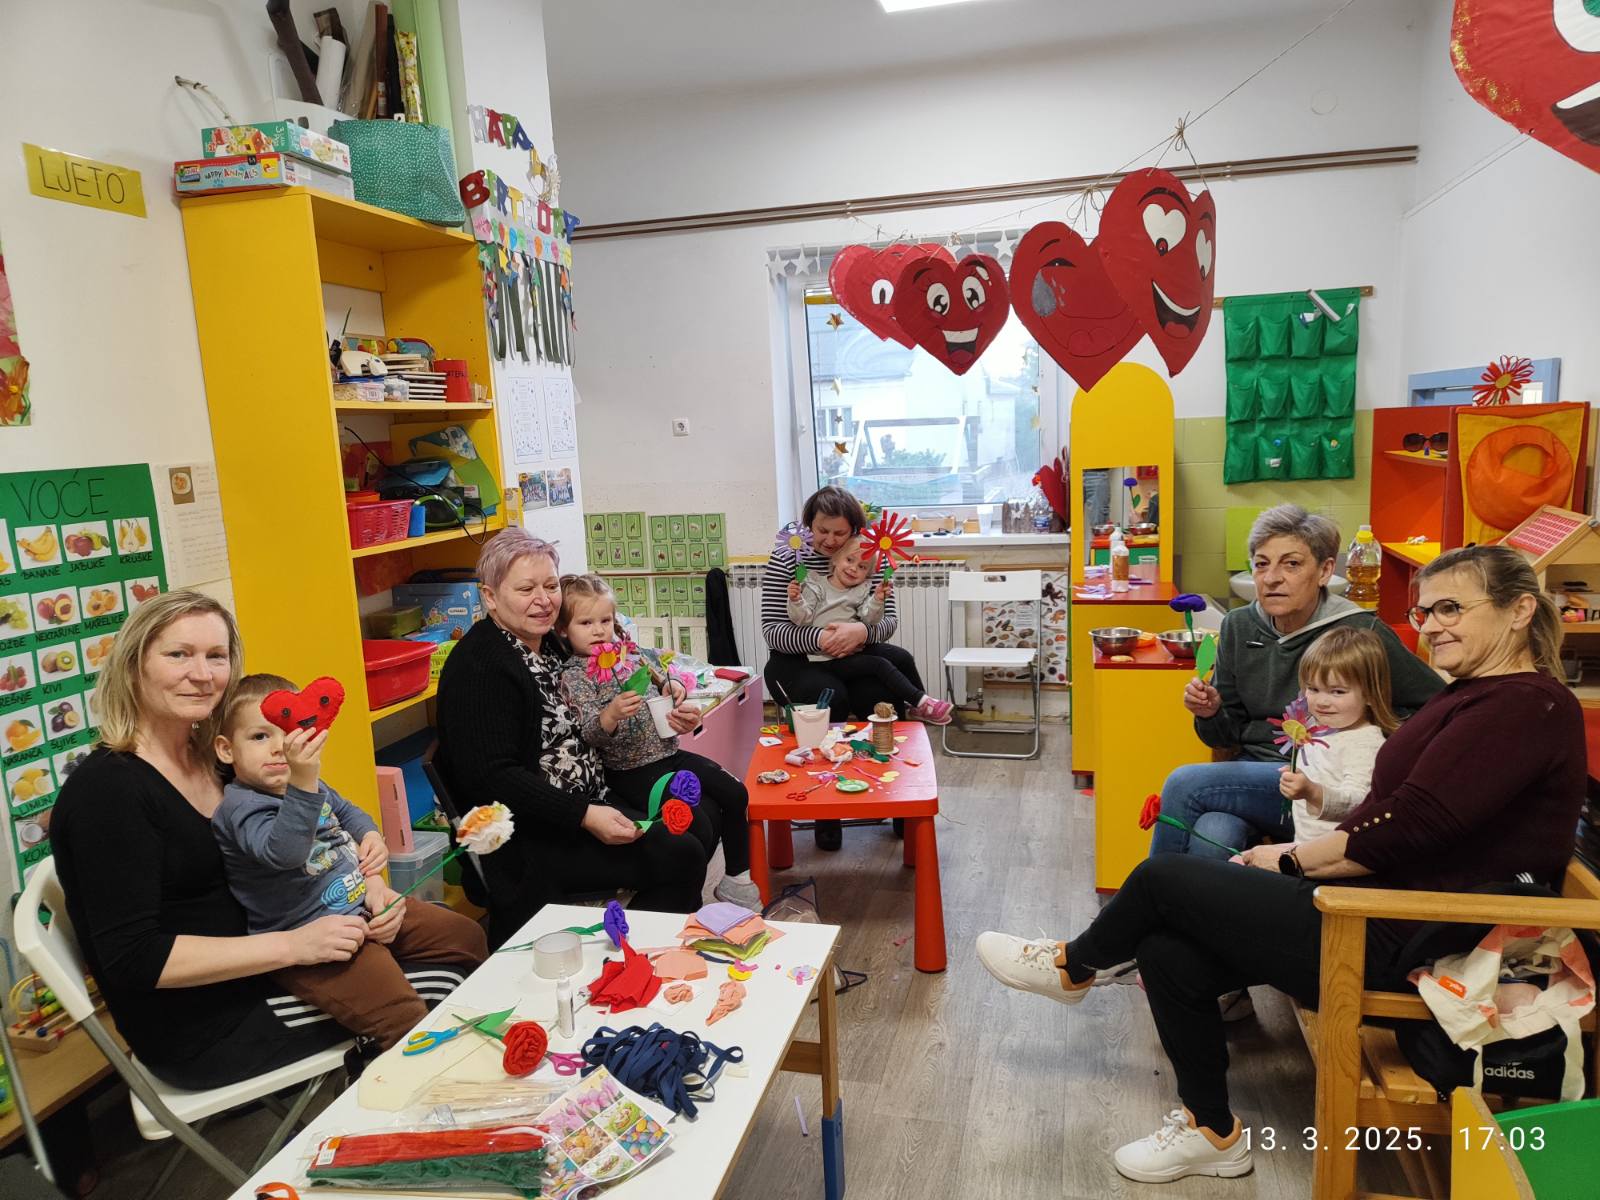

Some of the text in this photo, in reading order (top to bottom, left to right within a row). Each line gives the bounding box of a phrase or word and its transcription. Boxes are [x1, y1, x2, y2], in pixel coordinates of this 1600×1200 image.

[39, 156, 125, 204] LJETO
[10, 469, 109, 521] VOĆE
[22, 564, 62, 580] BANANE
[69, 558, 105, 573] JABUKE
[42, 684, 63, 696] KIVI
[24, 846, 51, 864] KOK
[1484, 1065, 1535, 1080] adidas
